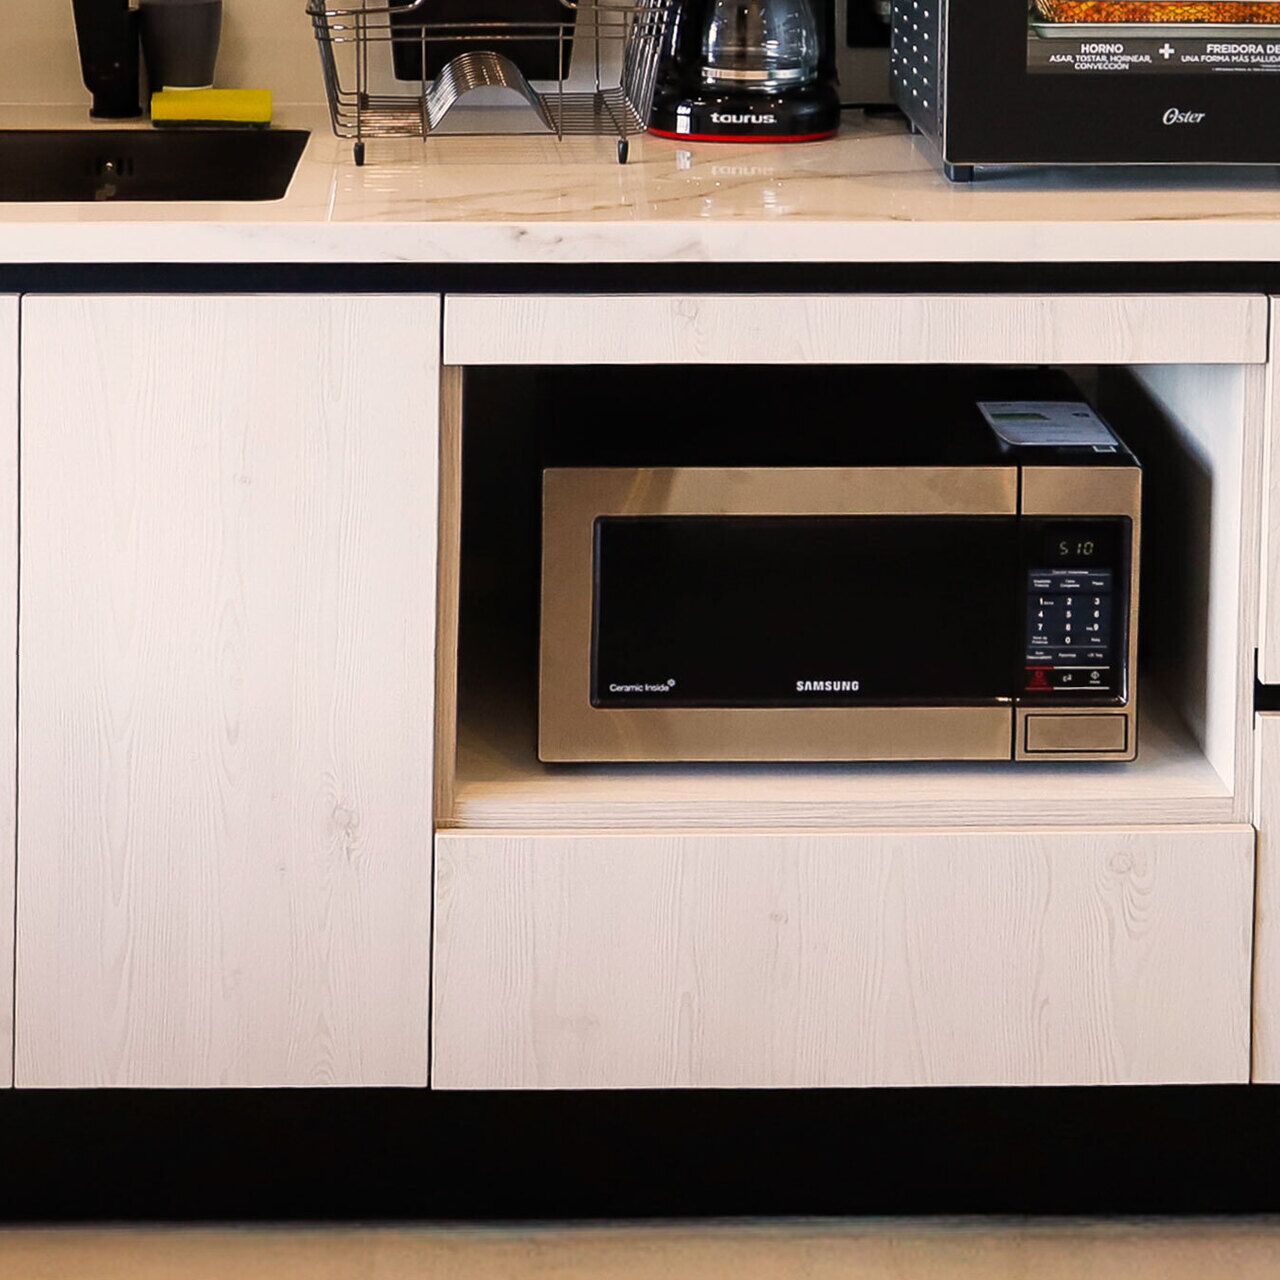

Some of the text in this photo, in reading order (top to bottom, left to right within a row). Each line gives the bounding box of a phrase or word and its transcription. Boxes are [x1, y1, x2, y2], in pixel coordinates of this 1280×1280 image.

[1080, 43, 1124, 54] HORNO
[1206, 44, 1263, 54] FREIDORA
[1266, 44, 1280, 54] DE
[1181, 55, 1199, 63] UNA
[1200, 55, 1230, 63] FORMA
[710, 112, 775, 123] taurus
[1162, 107, 1206, 125] Oster
[1039, 597, 1043, 605] 1
[1066, 597, 1072, 605] 2
[1038, 610, 1043, 618] 4
[1037, 623, 1043, 631] 7
[1065, 636, 1071, 644] 0
[609, 682, 669, 692] Ceramic Inside
[796, 681, 859, 691] SAMSUNG
